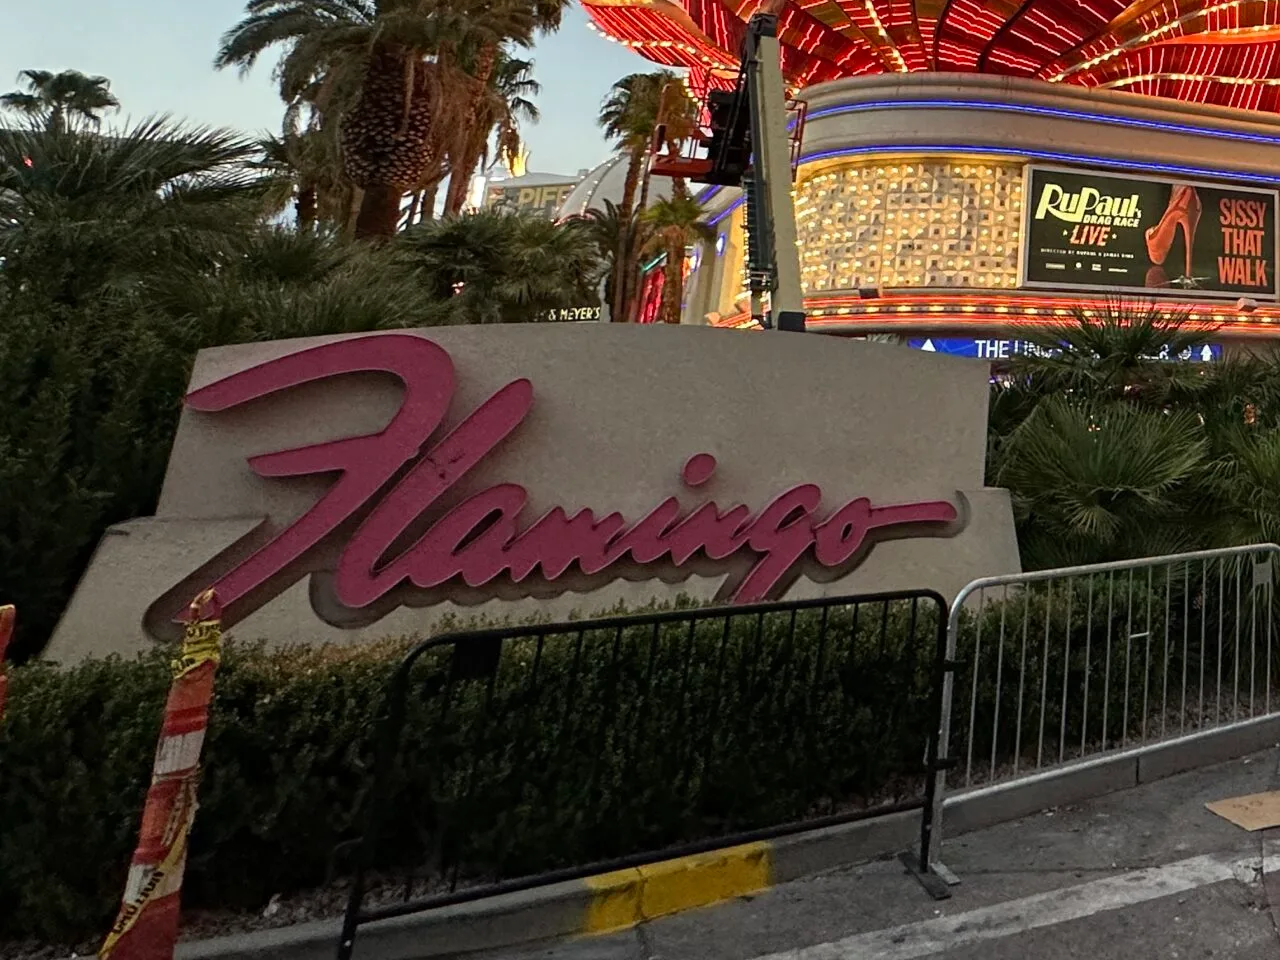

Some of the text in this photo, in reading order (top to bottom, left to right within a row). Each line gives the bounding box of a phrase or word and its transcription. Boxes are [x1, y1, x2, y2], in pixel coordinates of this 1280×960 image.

[1082, 214, 1140, 228] DRAG RACE
[1219, 198, 1267, 228] SISSY
[1070, 224, 1112, 247] LIVE
[1221, 227, 1265, 257] THAT
[1217, 256, 1268, 287] WALK
[560, 306, 601, 321] MEYER'S
[974, 340, 1010, 358] THE
[171, 334, 957, 622] Flamingo
